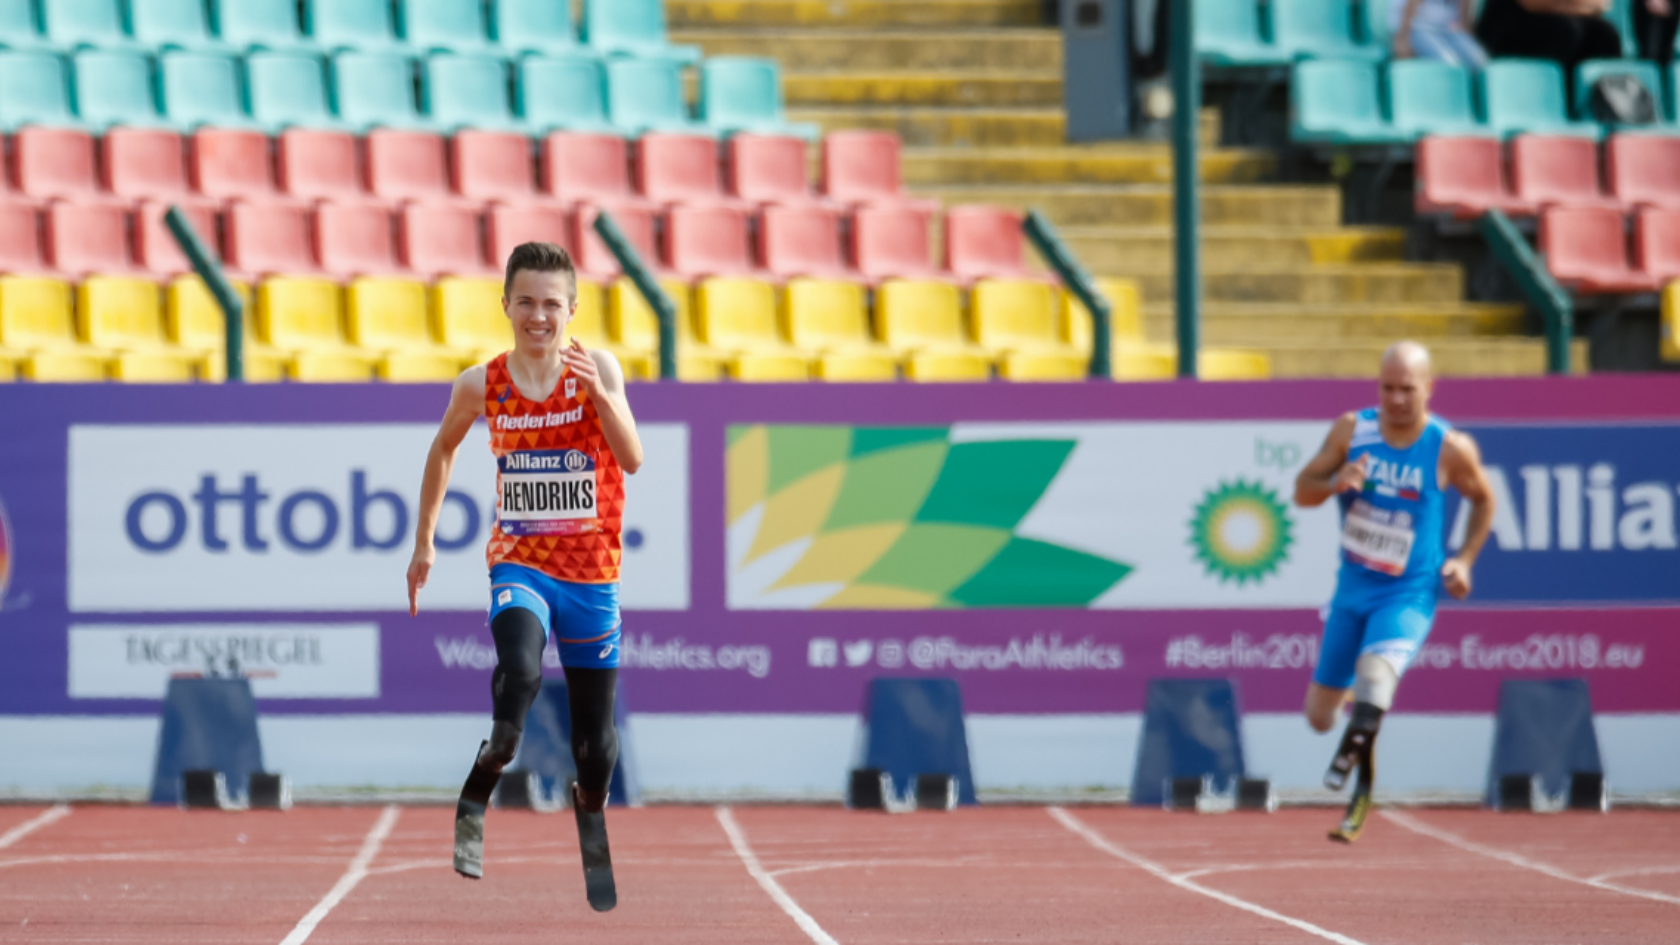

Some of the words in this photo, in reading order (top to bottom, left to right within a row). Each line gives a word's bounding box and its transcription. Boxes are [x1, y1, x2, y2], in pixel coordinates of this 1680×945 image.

[505, 453, 561, 470] Allianz
[1255, 436, 1303, 473] bp
[1366, 455, 1423, 493] TALIA
[503, 479, 594, 512] HENDRIKS
[1447, 463, 1680, 551] Allia
[908, 632, 1123, 671] @ParaAthletics
